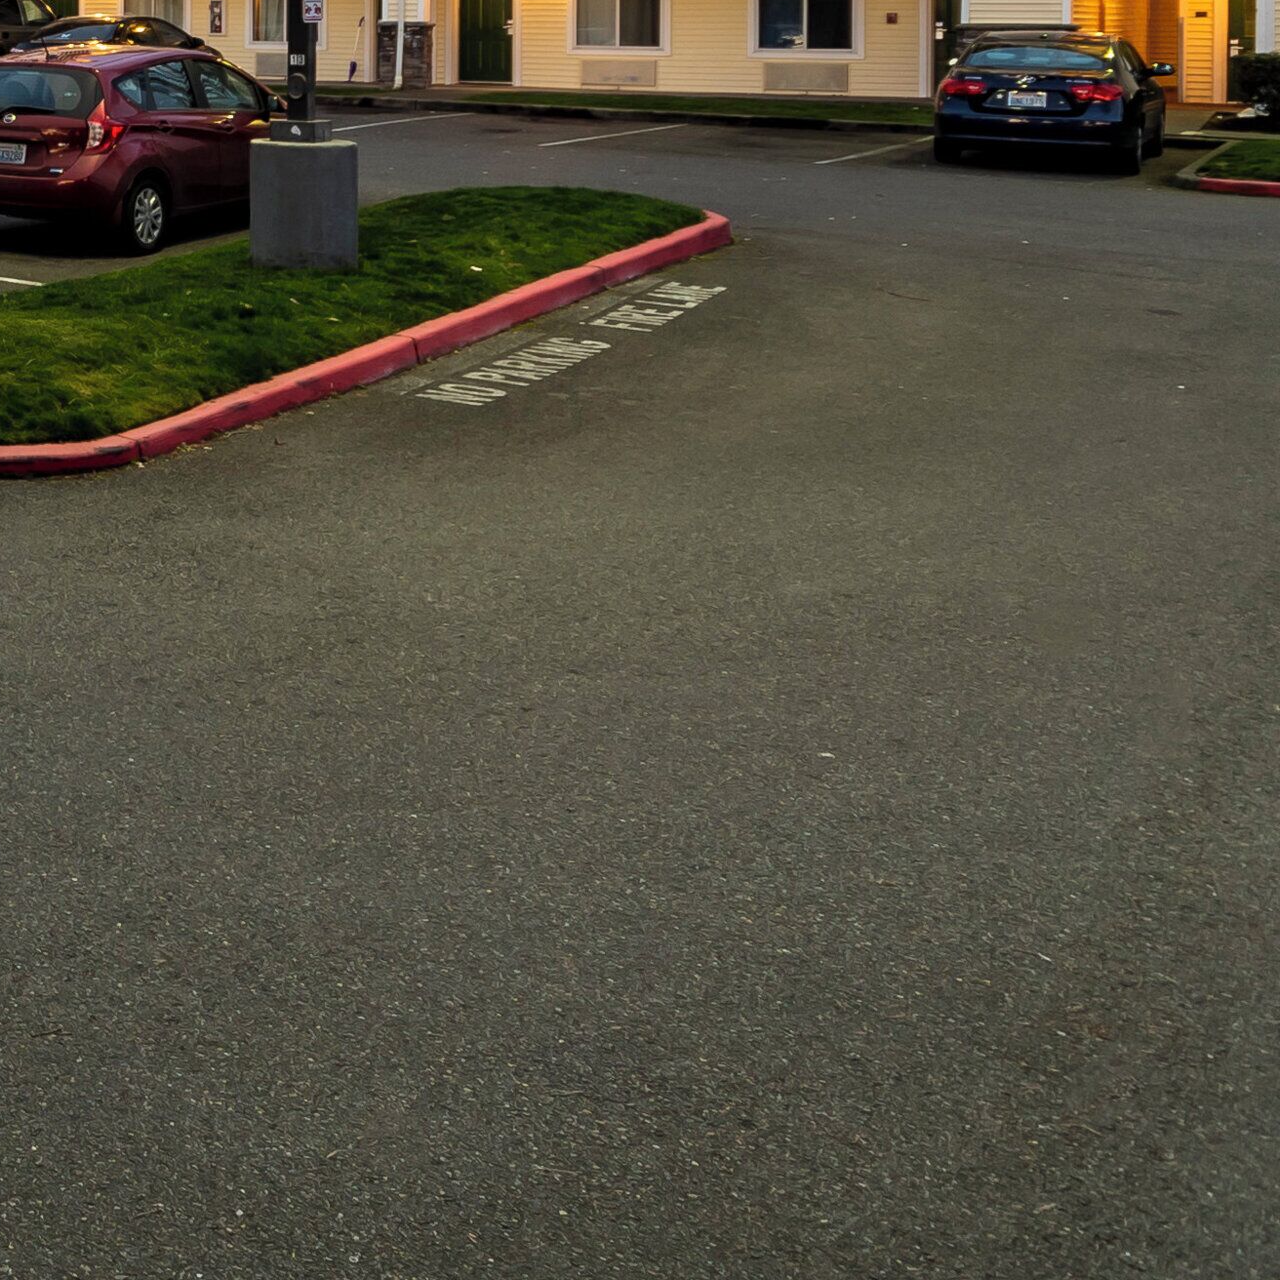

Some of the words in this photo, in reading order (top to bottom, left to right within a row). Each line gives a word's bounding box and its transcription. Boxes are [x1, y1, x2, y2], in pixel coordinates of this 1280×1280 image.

[634, 282, 727, 308] LANE
[589, 305, 684, 332] FIRE
[462, 337, 611, 386] PARKING
[415, 383, 507, 406] NO
